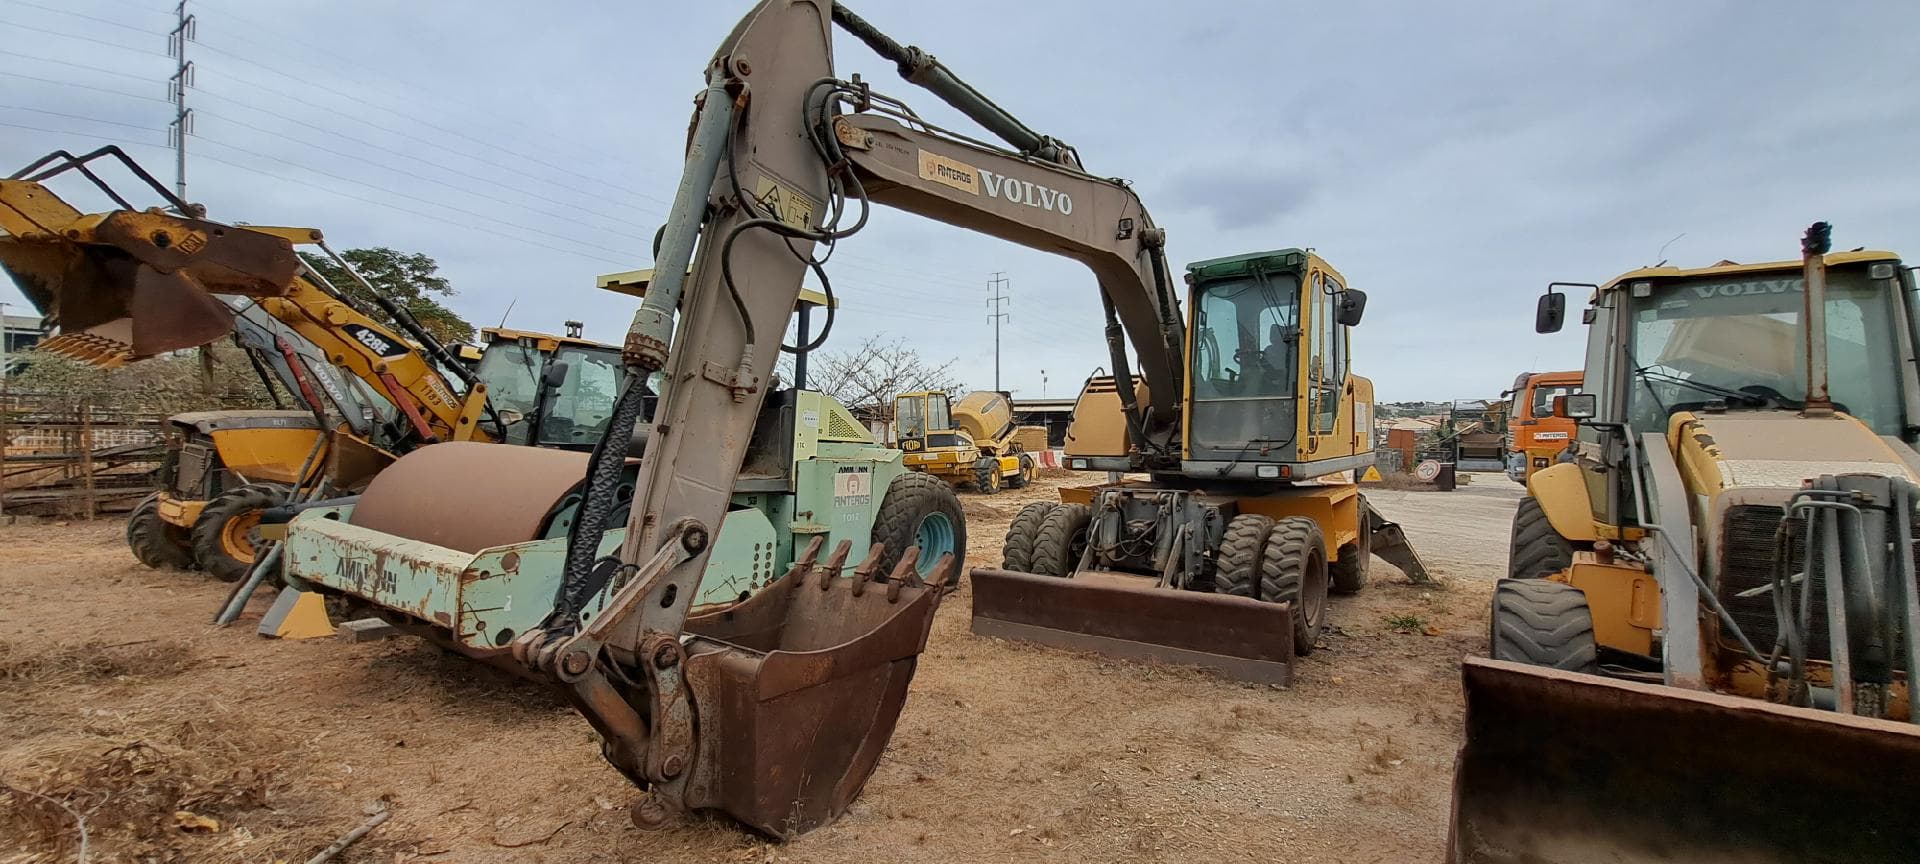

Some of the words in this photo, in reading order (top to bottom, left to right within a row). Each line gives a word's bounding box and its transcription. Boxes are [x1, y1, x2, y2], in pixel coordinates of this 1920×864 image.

[937, 163, 972, 185] ANTEROS
[977, 168, 1073, 216] VOLVO
[356, 329, 391, 355] 428E
[314, 362, 344, 400] VOLVO
[1419, 463, 1435, 477] 20
[834, 495, 870, 507] ANTEROS
